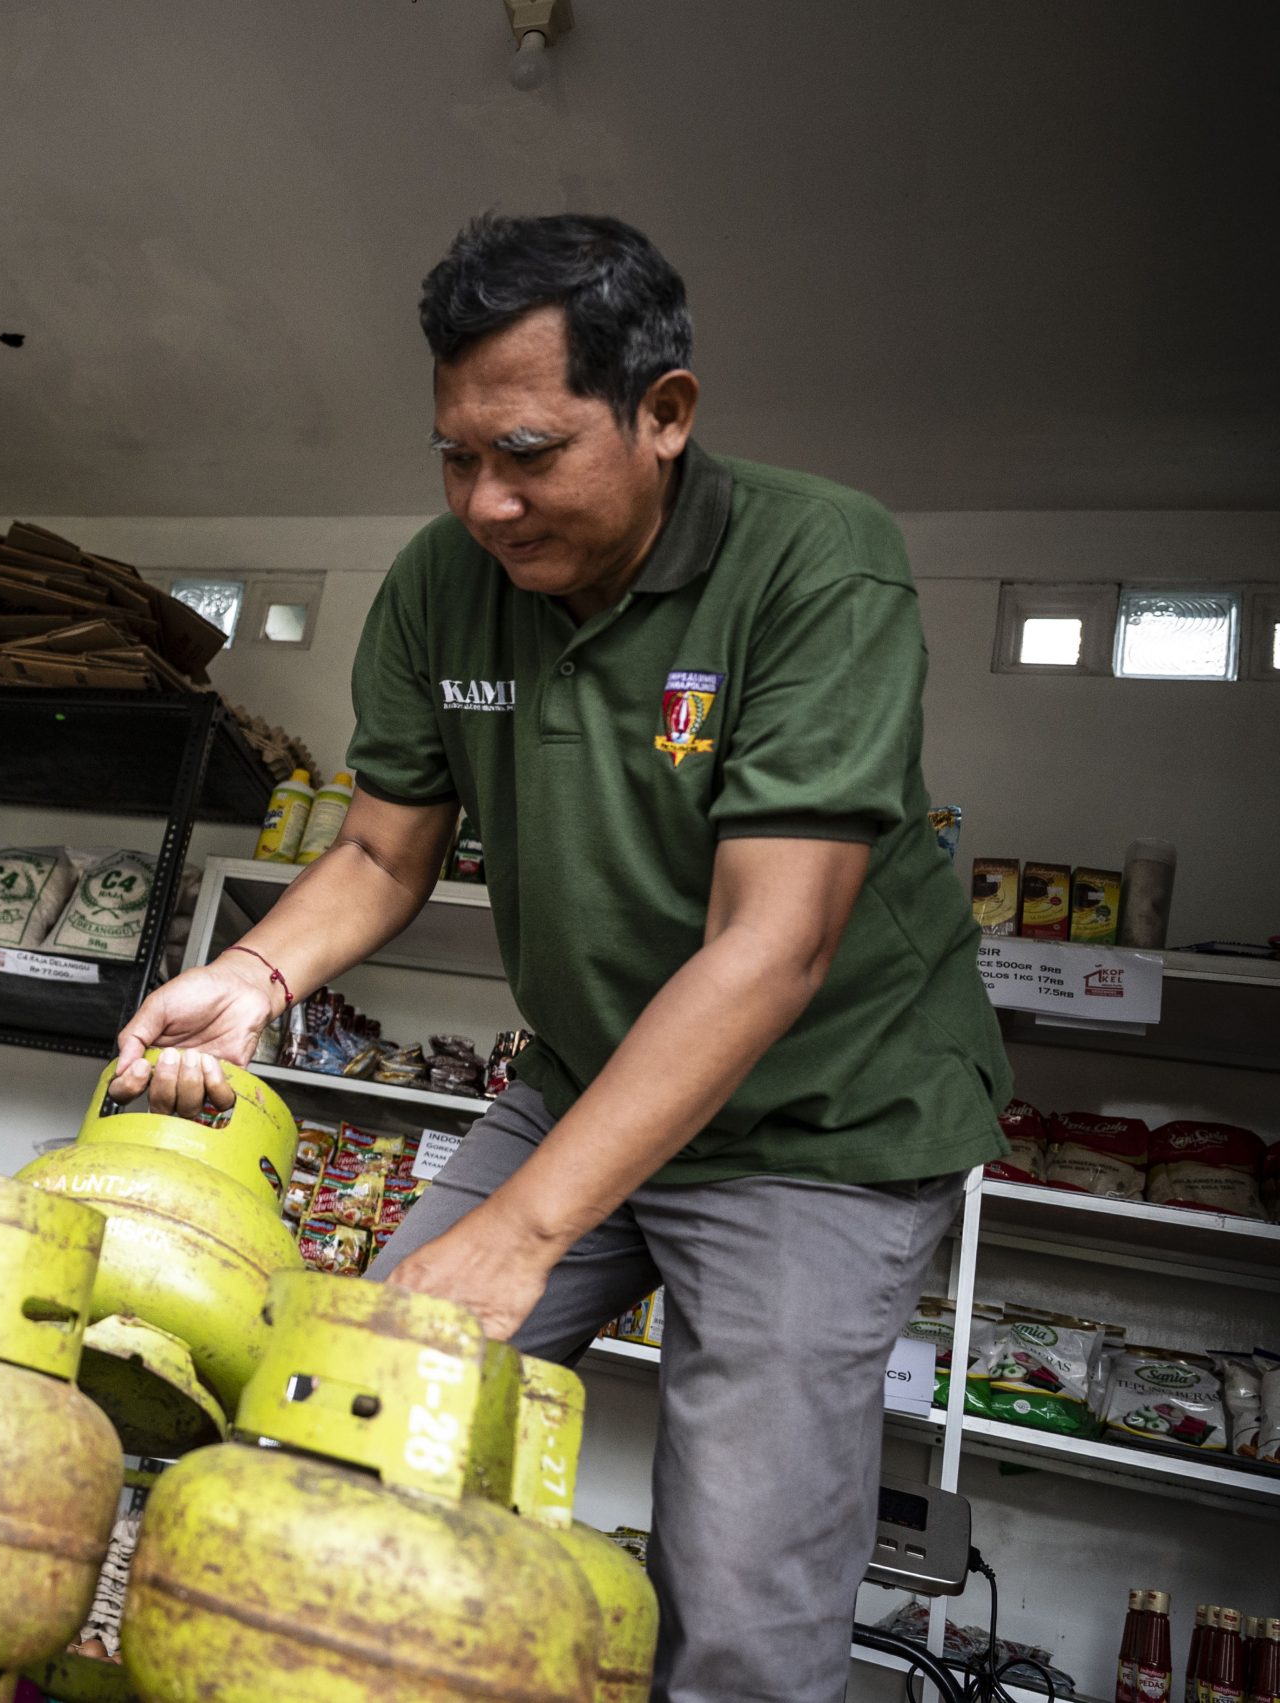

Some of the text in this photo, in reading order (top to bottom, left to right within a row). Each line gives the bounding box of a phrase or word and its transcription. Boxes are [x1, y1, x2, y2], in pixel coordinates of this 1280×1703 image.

[101, 871, 137, 892] C4
[76, 920, 130, 936] DELANGGU
[49, 958, 90, 971] DELANGGU
[996, 961, 1032, 970] 500GR
[1040, 965, 1061, 974] 9RB
[980, 971, 1064, 985] OLOS 1KG 17RB
[1038, 987, 1074, 998] 17.5RB
[885, 1371, 912, 1382] CS)
[1147, 1370, 1188, 1385] Sania
[1139, 1679, 1165, 1690] PEDAS
